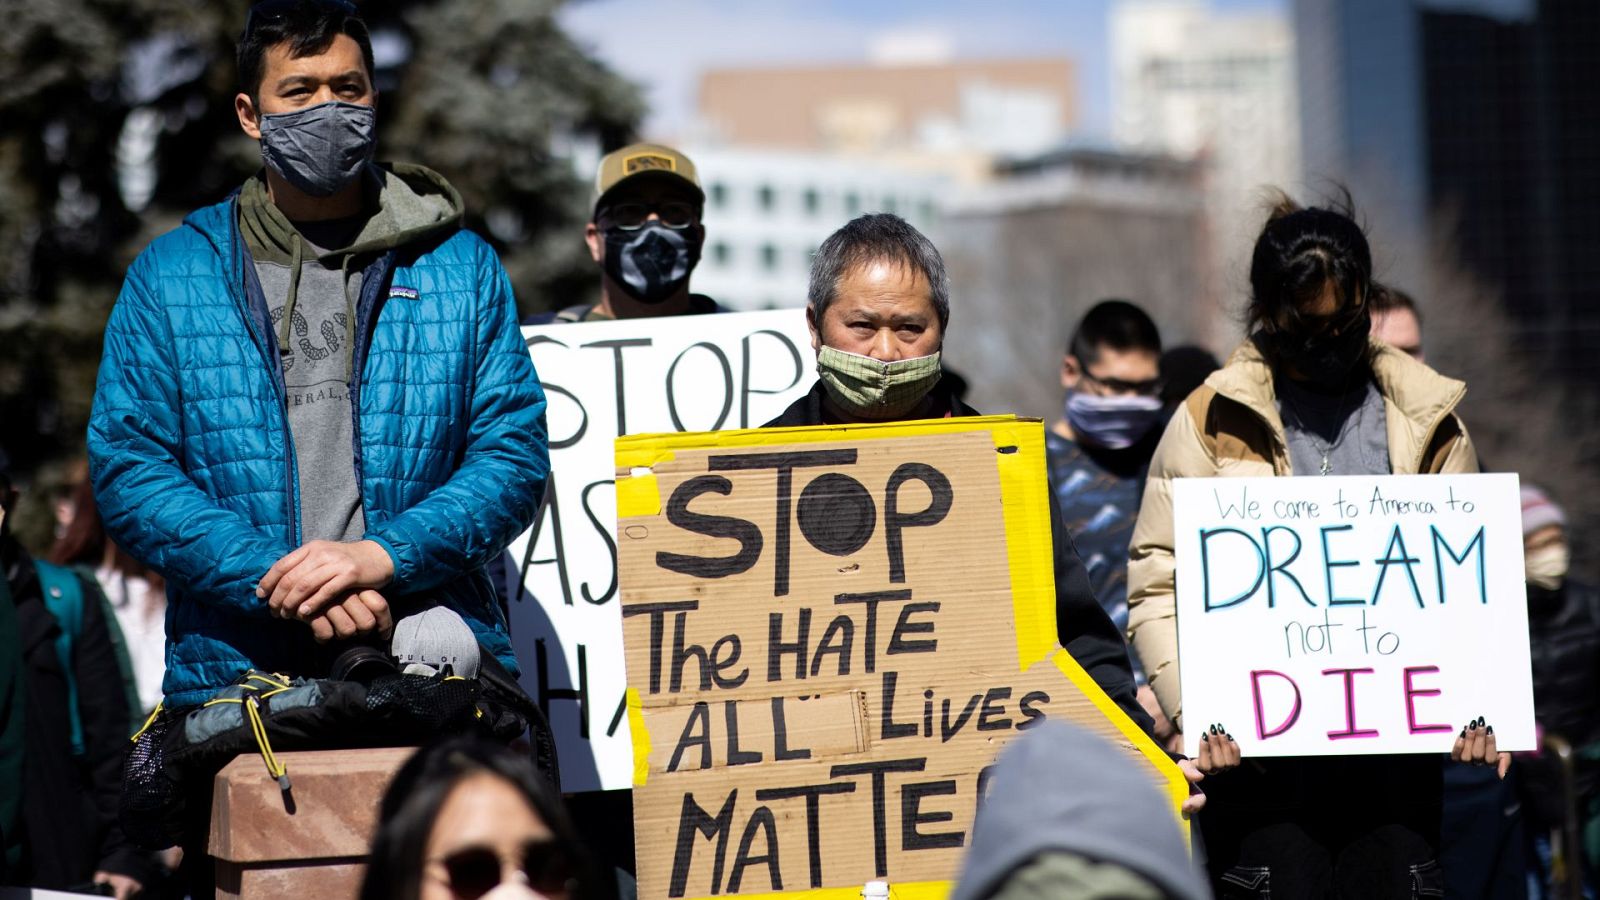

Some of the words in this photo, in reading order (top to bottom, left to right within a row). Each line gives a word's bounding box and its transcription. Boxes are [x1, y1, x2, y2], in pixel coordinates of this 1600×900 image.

[287, 387, 342, 406] ERAL,
[526, 329, 804, 450] STOP
[655, 448, 954, 597] STOP
[1214, 486, 1261, 520] We
[1273, 499, 1320, 519] came
[1334, 488, 1359, 518] to
[1369, 486, 1437, 516] America
[1445, 486, 1475, 513] to
[1199, 524, 1488, 613] DREAM
[622, 600, 749, 694] The
[767, 588, 942, 682] HATE
[1284, 609, 1344, 658] not
[1356, 609, 1400, 655] to
[535, 637, 628, 740] H
[1250, 665, 1453, 740] DIE
[666, 695, 812, 773] ALL
